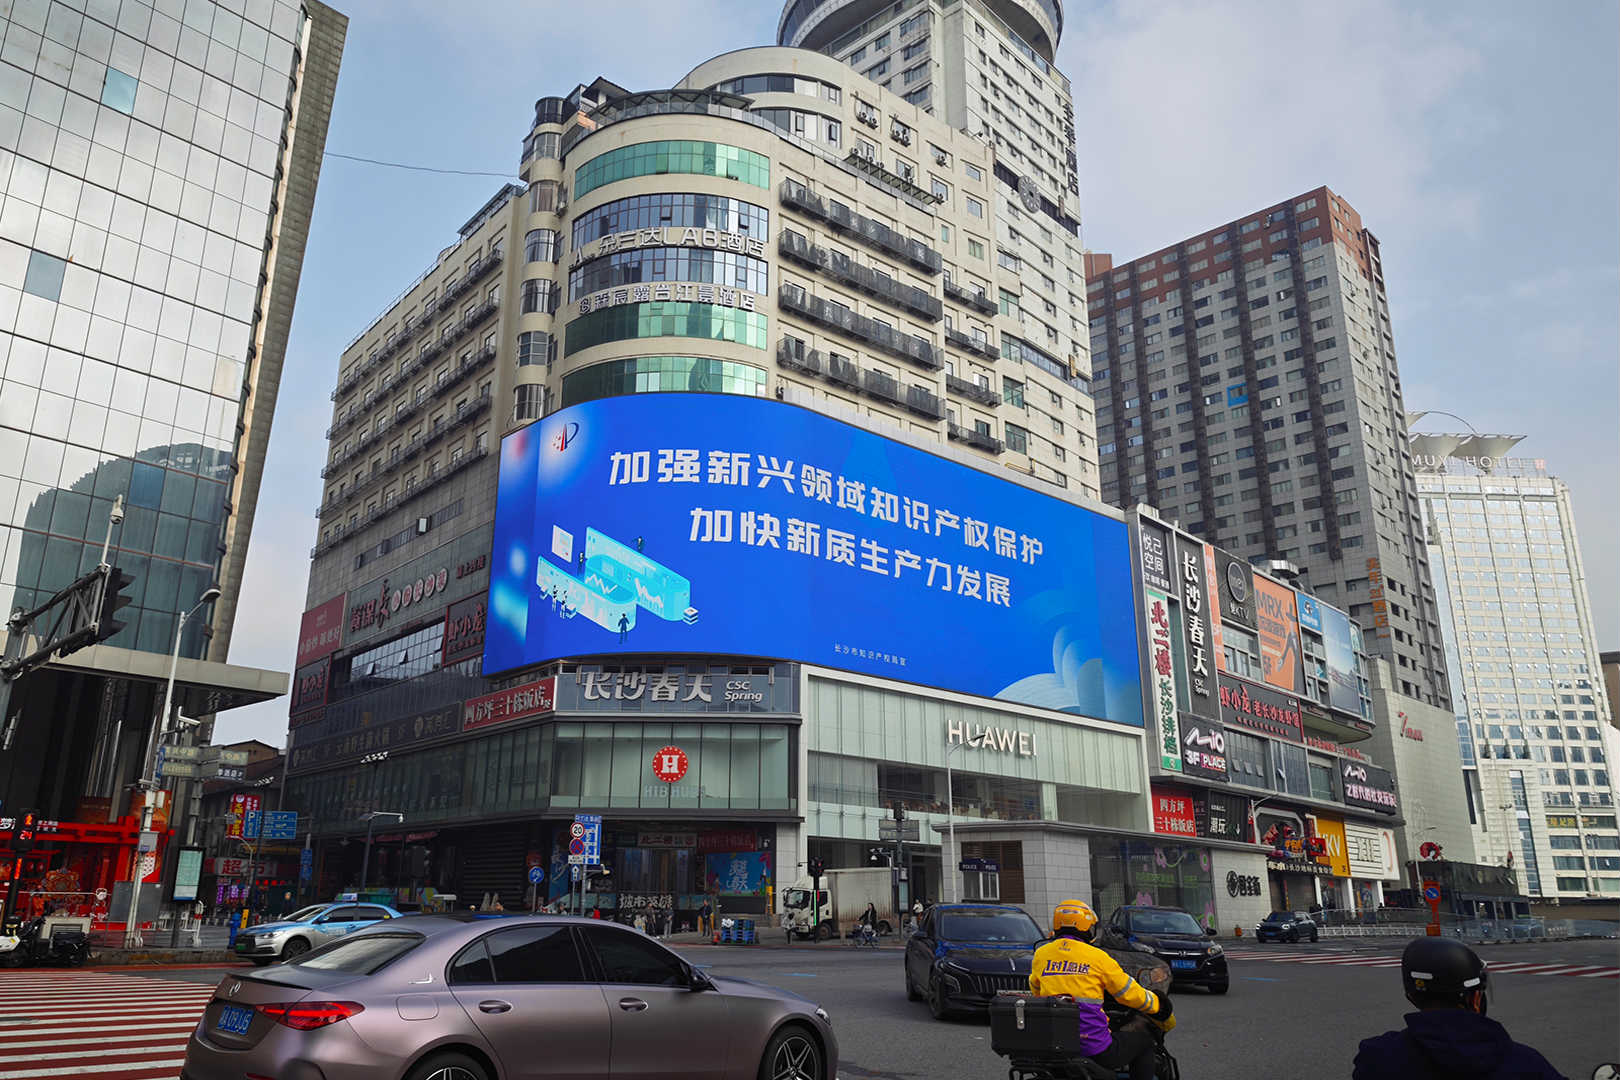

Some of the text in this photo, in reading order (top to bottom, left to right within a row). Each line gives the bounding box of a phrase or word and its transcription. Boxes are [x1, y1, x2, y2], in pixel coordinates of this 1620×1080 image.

[608, 448, 1044, 563] 加强新兴领域知识产权保护
[690, 507, 1012, 608] 加快新质生产力发展
[1183, 551, 1209, 679] 长沙春天
[583, 671, 713, 704] 长沙春天
[724, 690, 763, 703] Spring
[726, 680, 751, 691] CSC
[947, 719, 1038, 757] HUAWEI
[573, 825, 583, 836] 20
